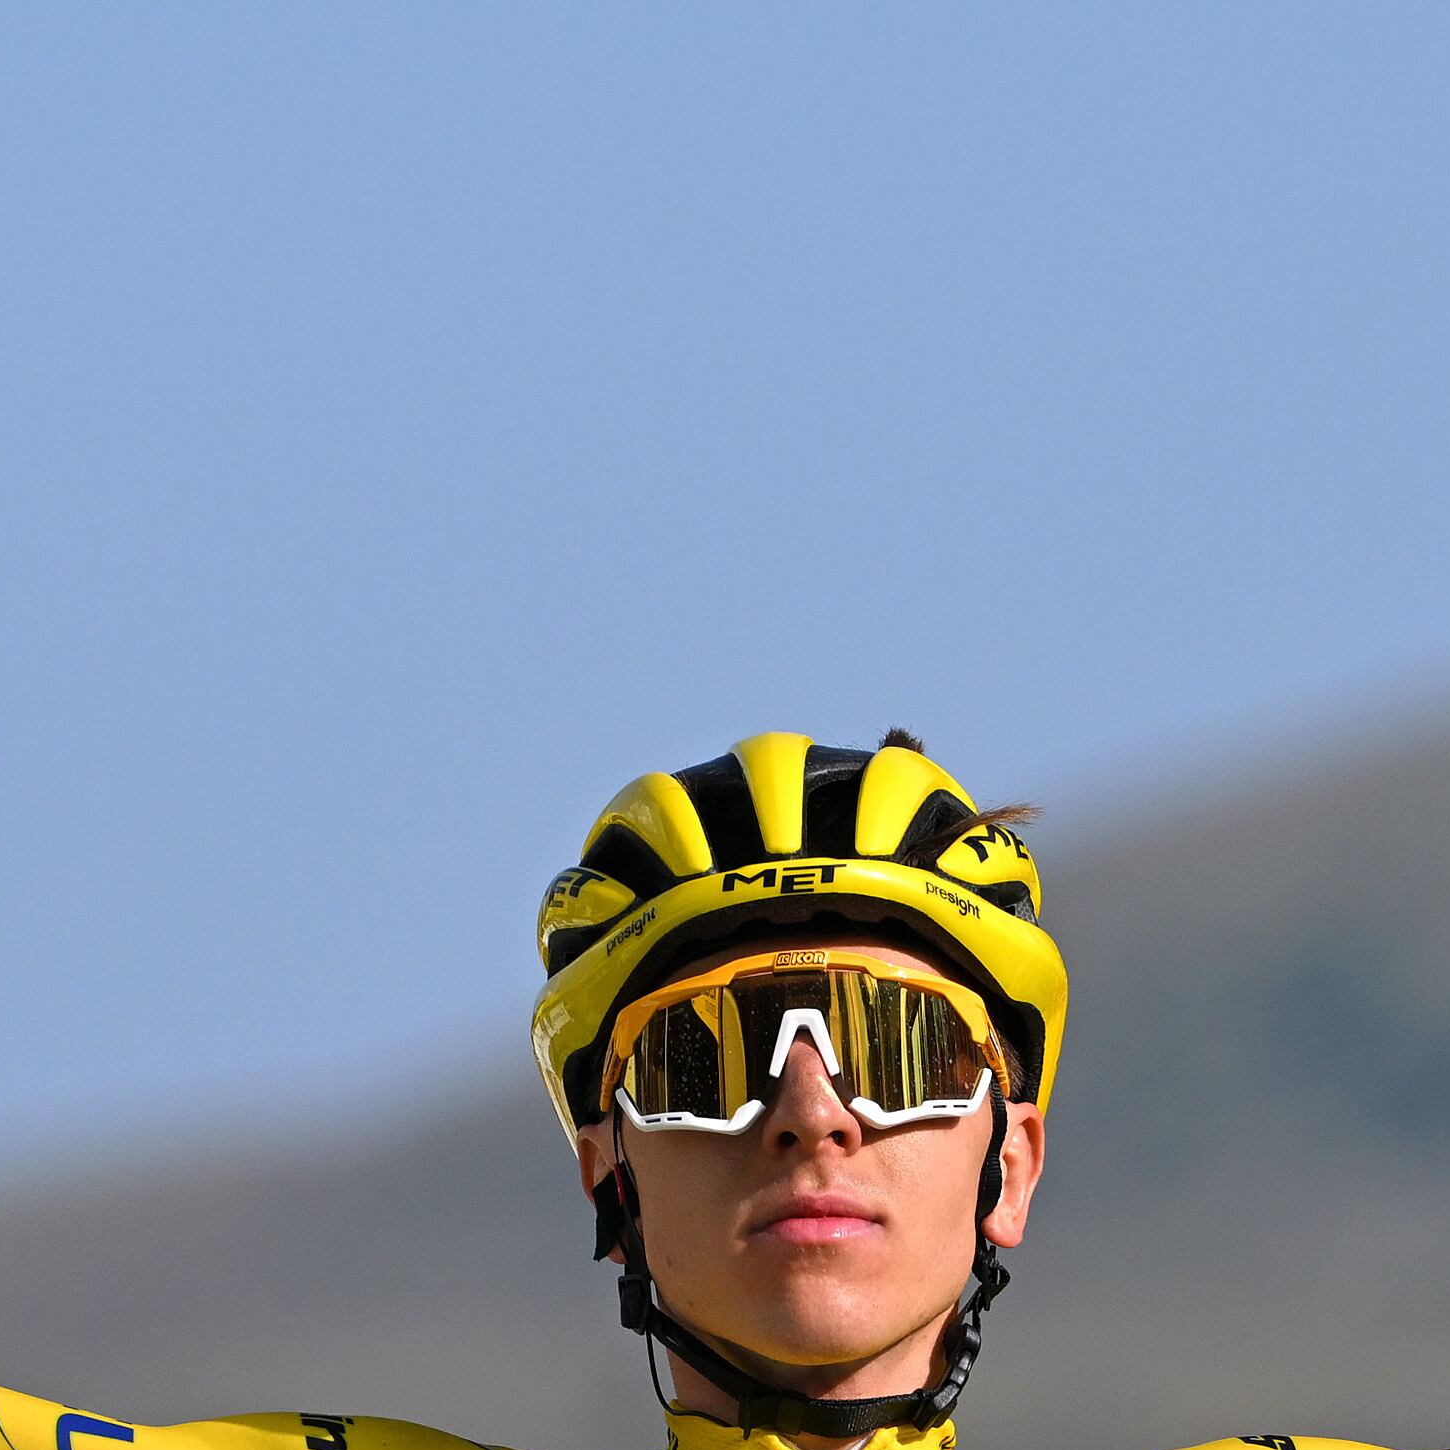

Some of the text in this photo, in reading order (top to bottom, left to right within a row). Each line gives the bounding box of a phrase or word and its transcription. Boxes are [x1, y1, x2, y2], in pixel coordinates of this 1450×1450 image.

[962, 824, 1029, 863] ME
[544, 867, 606, 908] ET
[722, 864, 847, 894] MET
[926, 882, 980, 919] presight
[606, 907, 656, 957] presight
